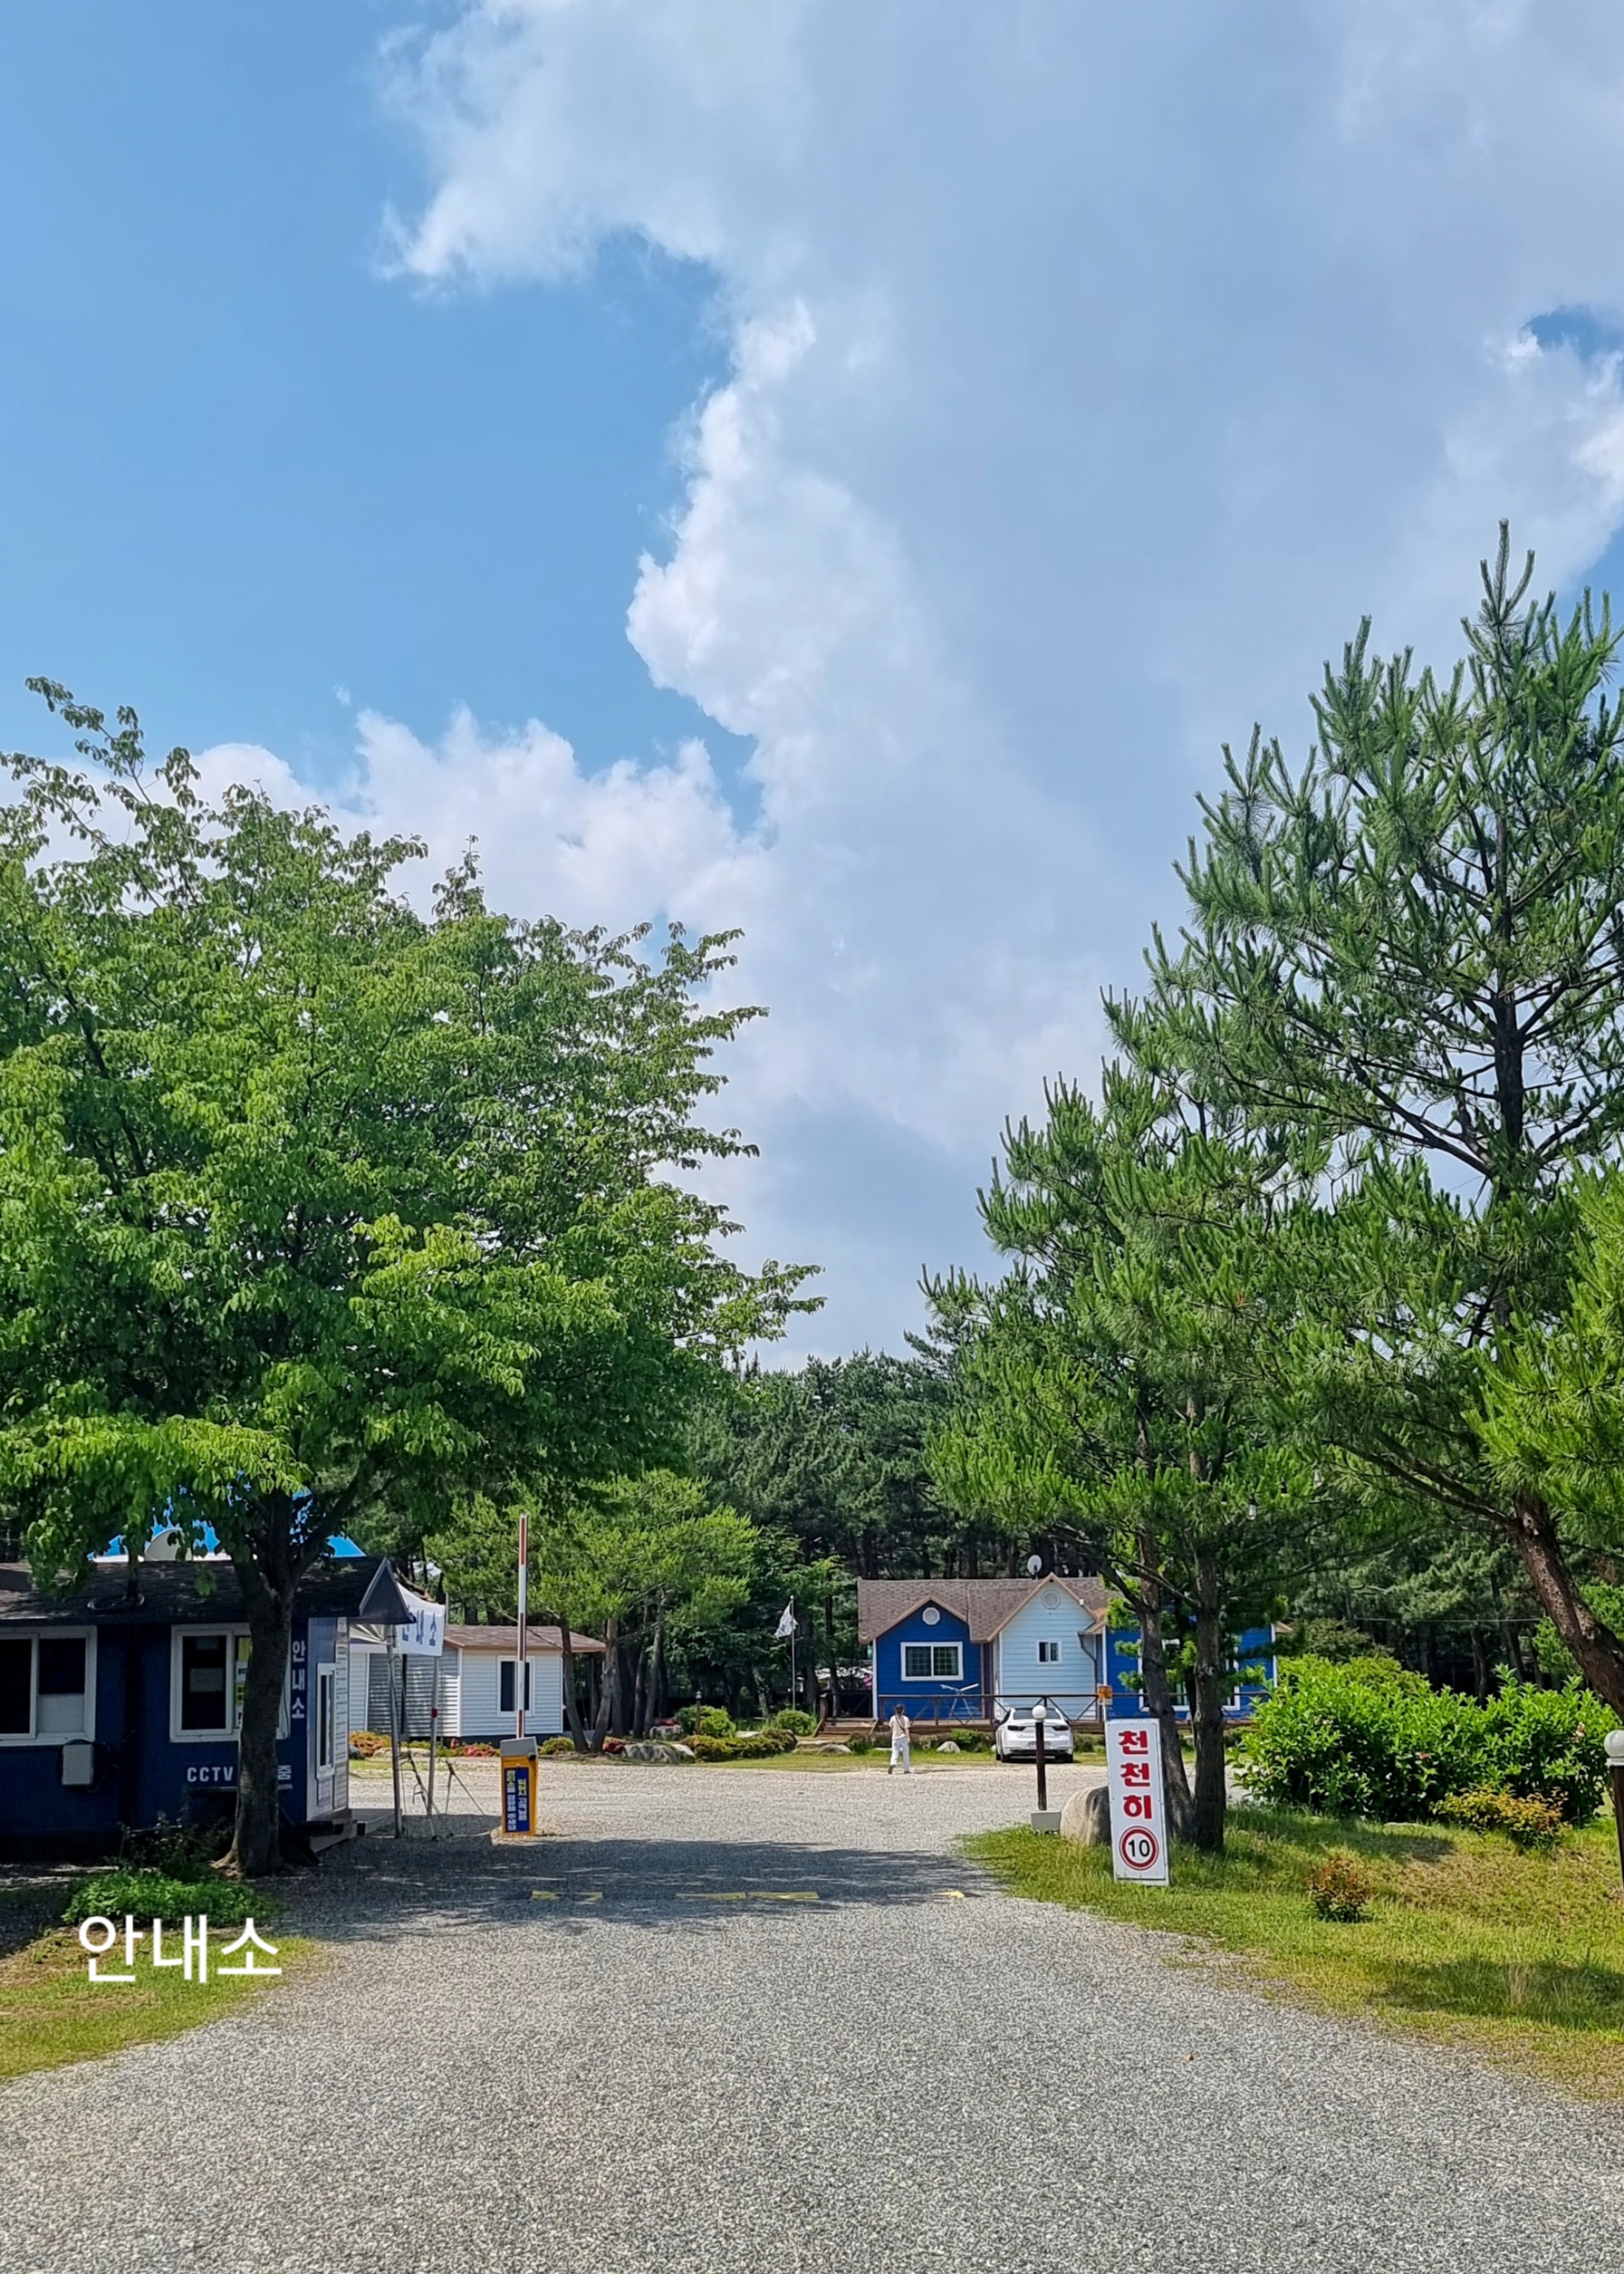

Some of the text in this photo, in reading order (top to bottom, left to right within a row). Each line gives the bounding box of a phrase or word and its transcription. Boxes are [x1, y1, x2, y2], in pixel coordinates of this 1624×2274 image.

[292, 1641, 306, 1719] 안내소
[187, 1765, 292, 1782] CCTV 중
[1119, 1730, 1152, 1819] 천천히
[1129, 1839, 1150, 1858] 10
